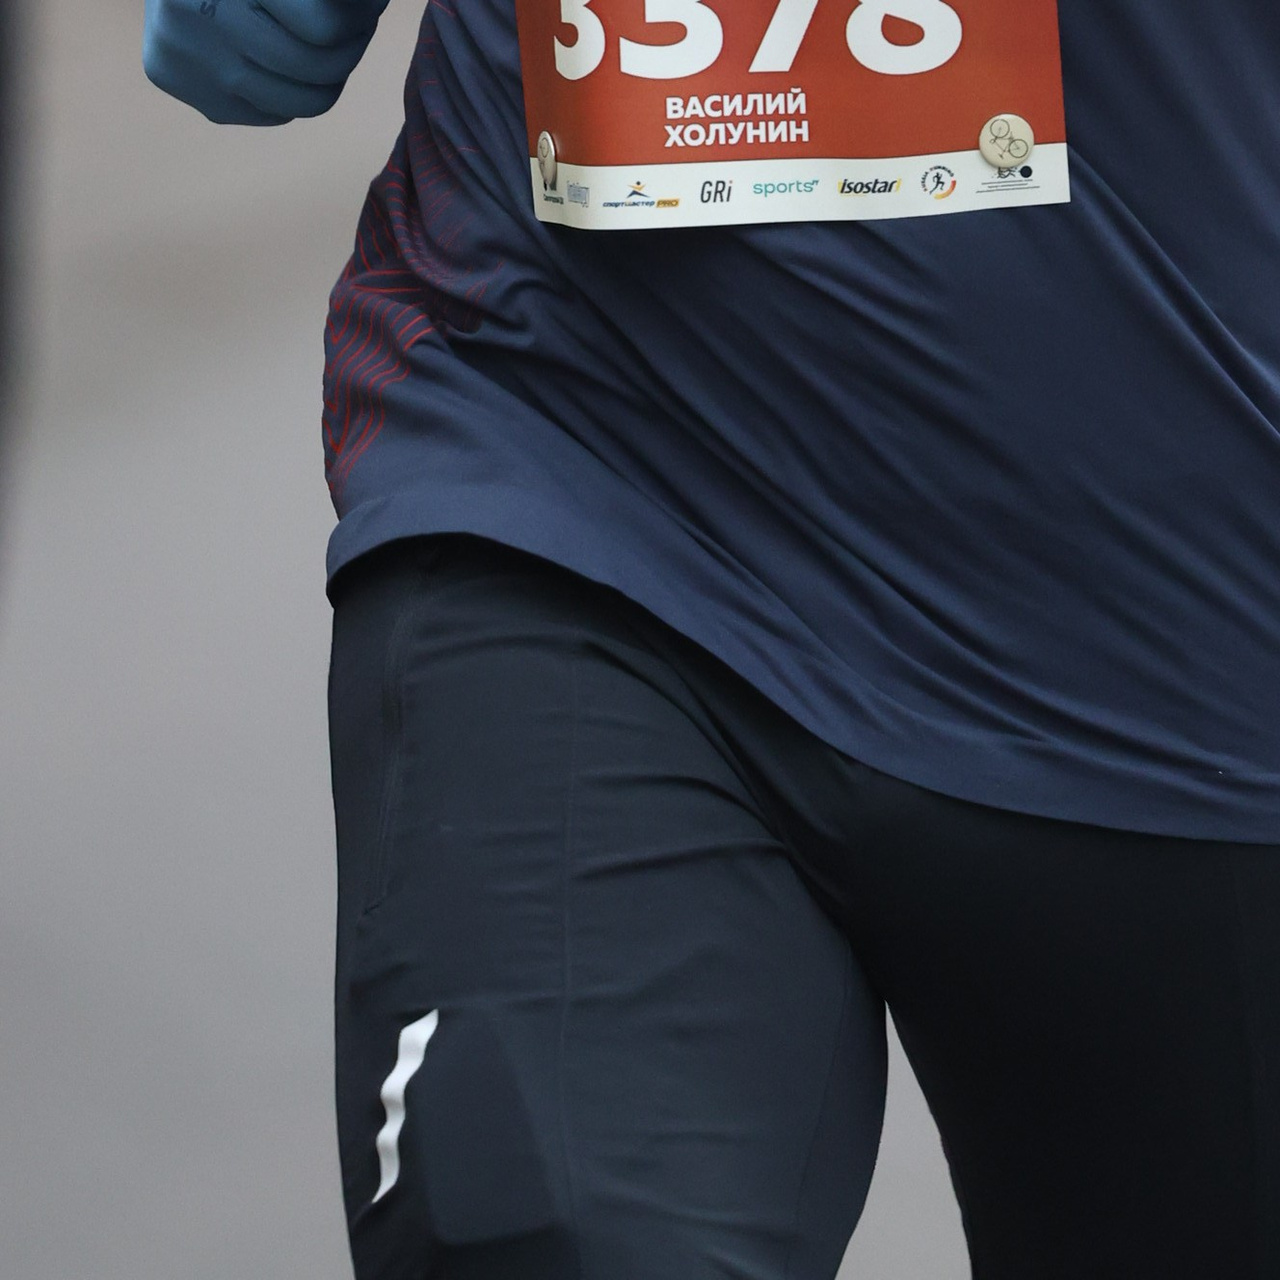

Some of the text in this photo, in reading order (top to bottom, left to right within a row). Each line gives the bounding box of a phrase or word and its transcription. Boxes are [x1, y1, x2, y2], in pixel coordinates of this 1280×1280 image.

[666, 87, 807, 119] ВАСИЛИЙ
[664, 120, 810, 148] ХОЛУНИН
[840, 178, 897, 194] isostar
